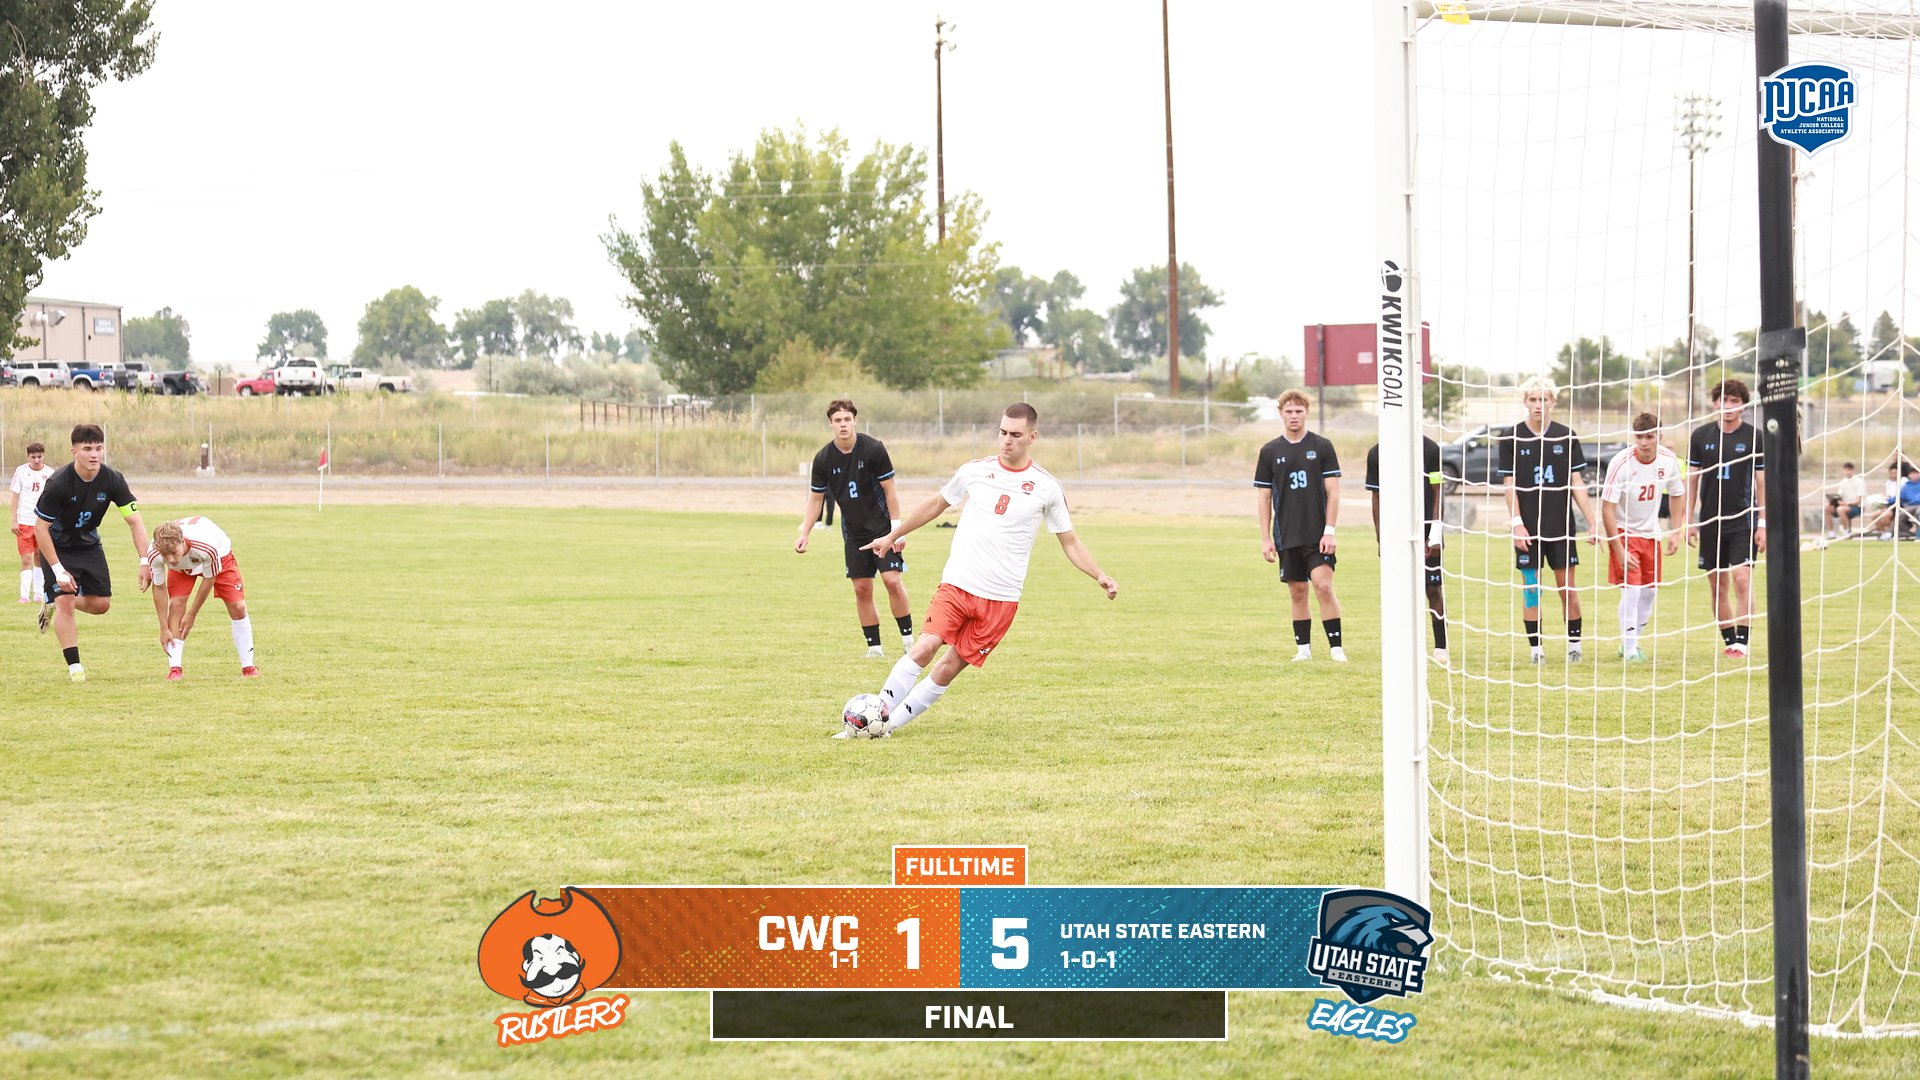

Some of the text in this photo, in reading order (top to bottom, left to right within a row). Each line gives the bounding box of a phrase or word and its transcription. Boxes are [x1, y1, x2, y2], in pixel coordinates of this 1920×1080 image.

[1289, 470, 1307, 489] 39
[1534, 465, 1554, 484] 24
[31, 482, 40, 492] 15
[848, 481, 858, 498] 2
[1638, 484, 1655, 501] 20
[994, 494, 1010, 515] 8
[75, 511, 92, 528] 32
